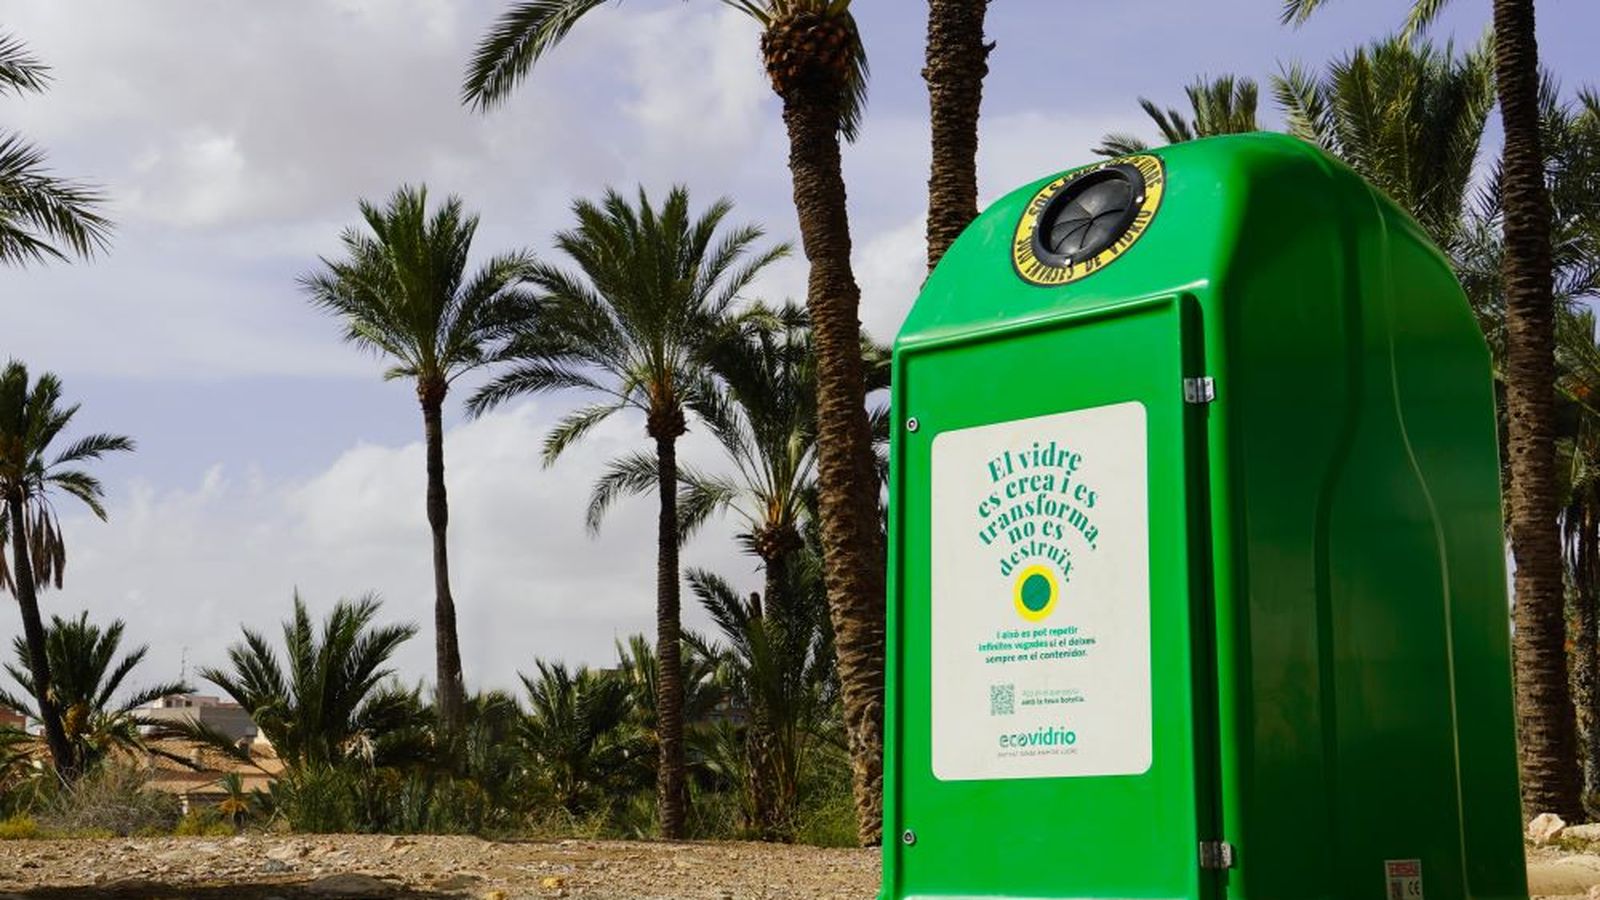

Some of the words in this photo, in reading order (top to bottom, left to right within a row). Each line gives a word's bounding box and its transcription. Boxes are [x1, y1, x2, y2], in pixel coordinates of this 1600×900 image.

[1085, 256, 1102, 272] DE
[988, 450, 1013, 482] El
[1018, 441, 1082, 471] vidre
[978, 493, 1001, 518] es
[1006, 474, 1055, 499] crea
[1061, 470, 1071, 494] i
[1074, 484, 1097, 508] es
[1008, 521, 1035, 545] no
[1042, 520, 1064, 540] es
[1033, 628, 1047, 639] pot
[1049, 625, 1078, 637] repetir
[1015, 639, 1048, 651] vegades
[985, 653, 1015, 664] sempre
[1017, 653, 1028, 661] en
[1030, 651, 1037, 660] el
[999, 726, 1076, 748] ecovidrio
